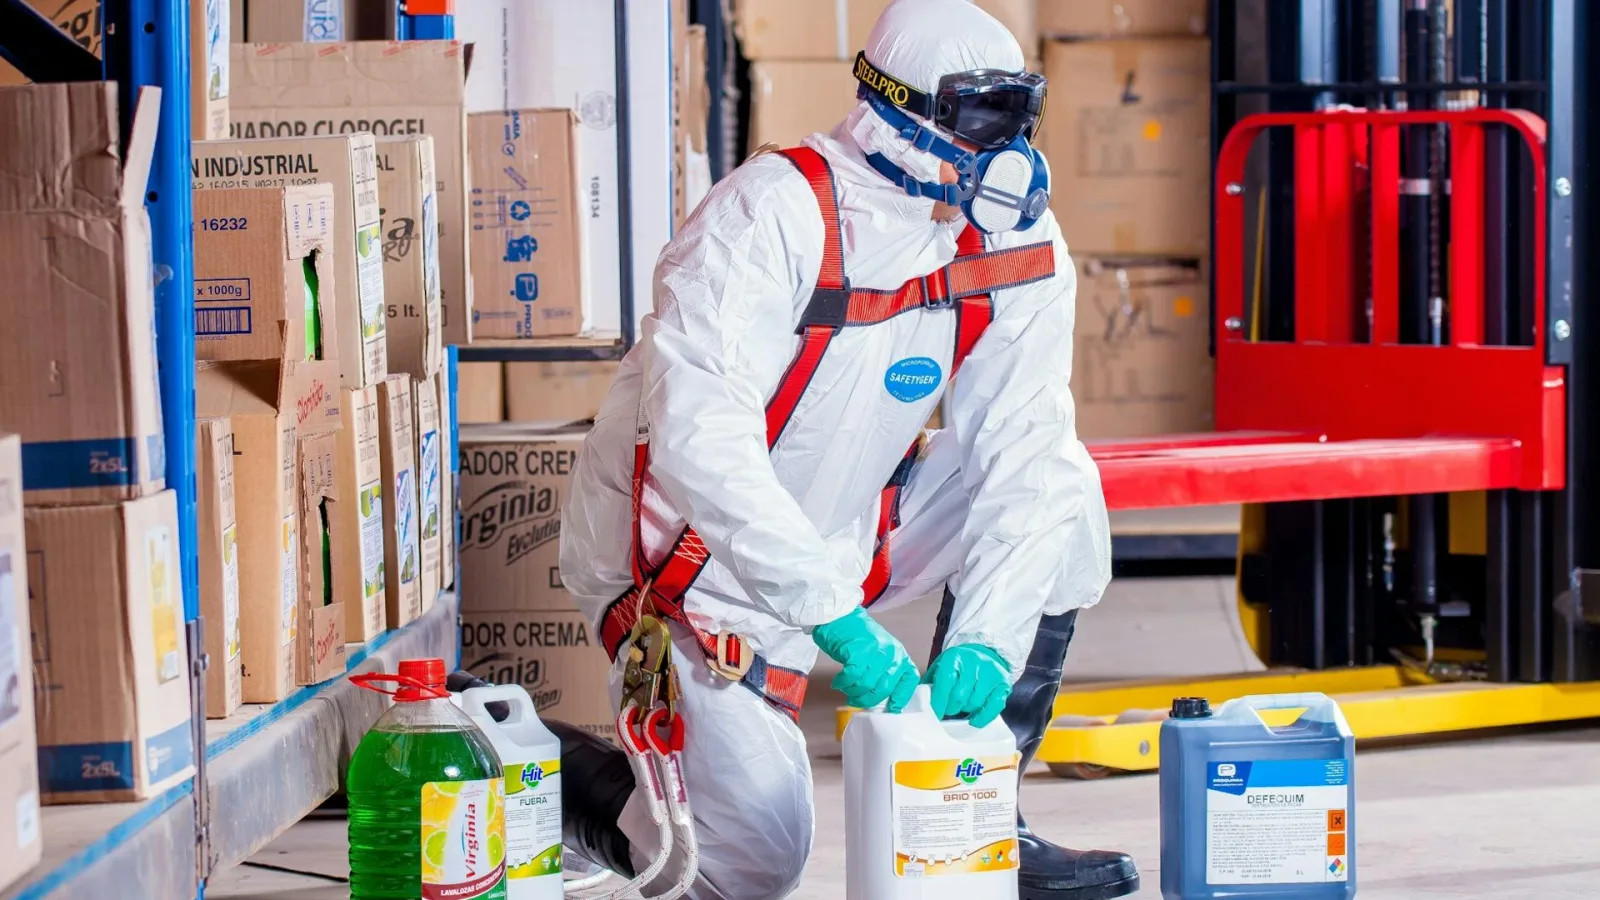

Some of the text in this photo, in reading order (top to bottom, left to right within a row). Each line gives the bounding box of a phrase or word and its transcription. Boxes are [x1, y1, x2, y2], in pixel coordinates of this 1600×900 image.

[856, 57, 908, 107] STEELPRO
[205, 153, 319, 178] INDUSTRIAL
[201, 217, 247, 231] 16232
[208, 285, 242, 297] 1000g
[889, 372, 936, 385] SAFETYGEN
[513, 622, 589, 647] CREMA
[521, 765, 544, 782] Hit
[955, 761, 984, 777] Hit
[519, 796, 548, 806] FUERA
[972, 790, 997, 800] 1000
[1246, 794, 1305, 805] DEFEQUIM
[464, 801, 480, 879] Virginia
